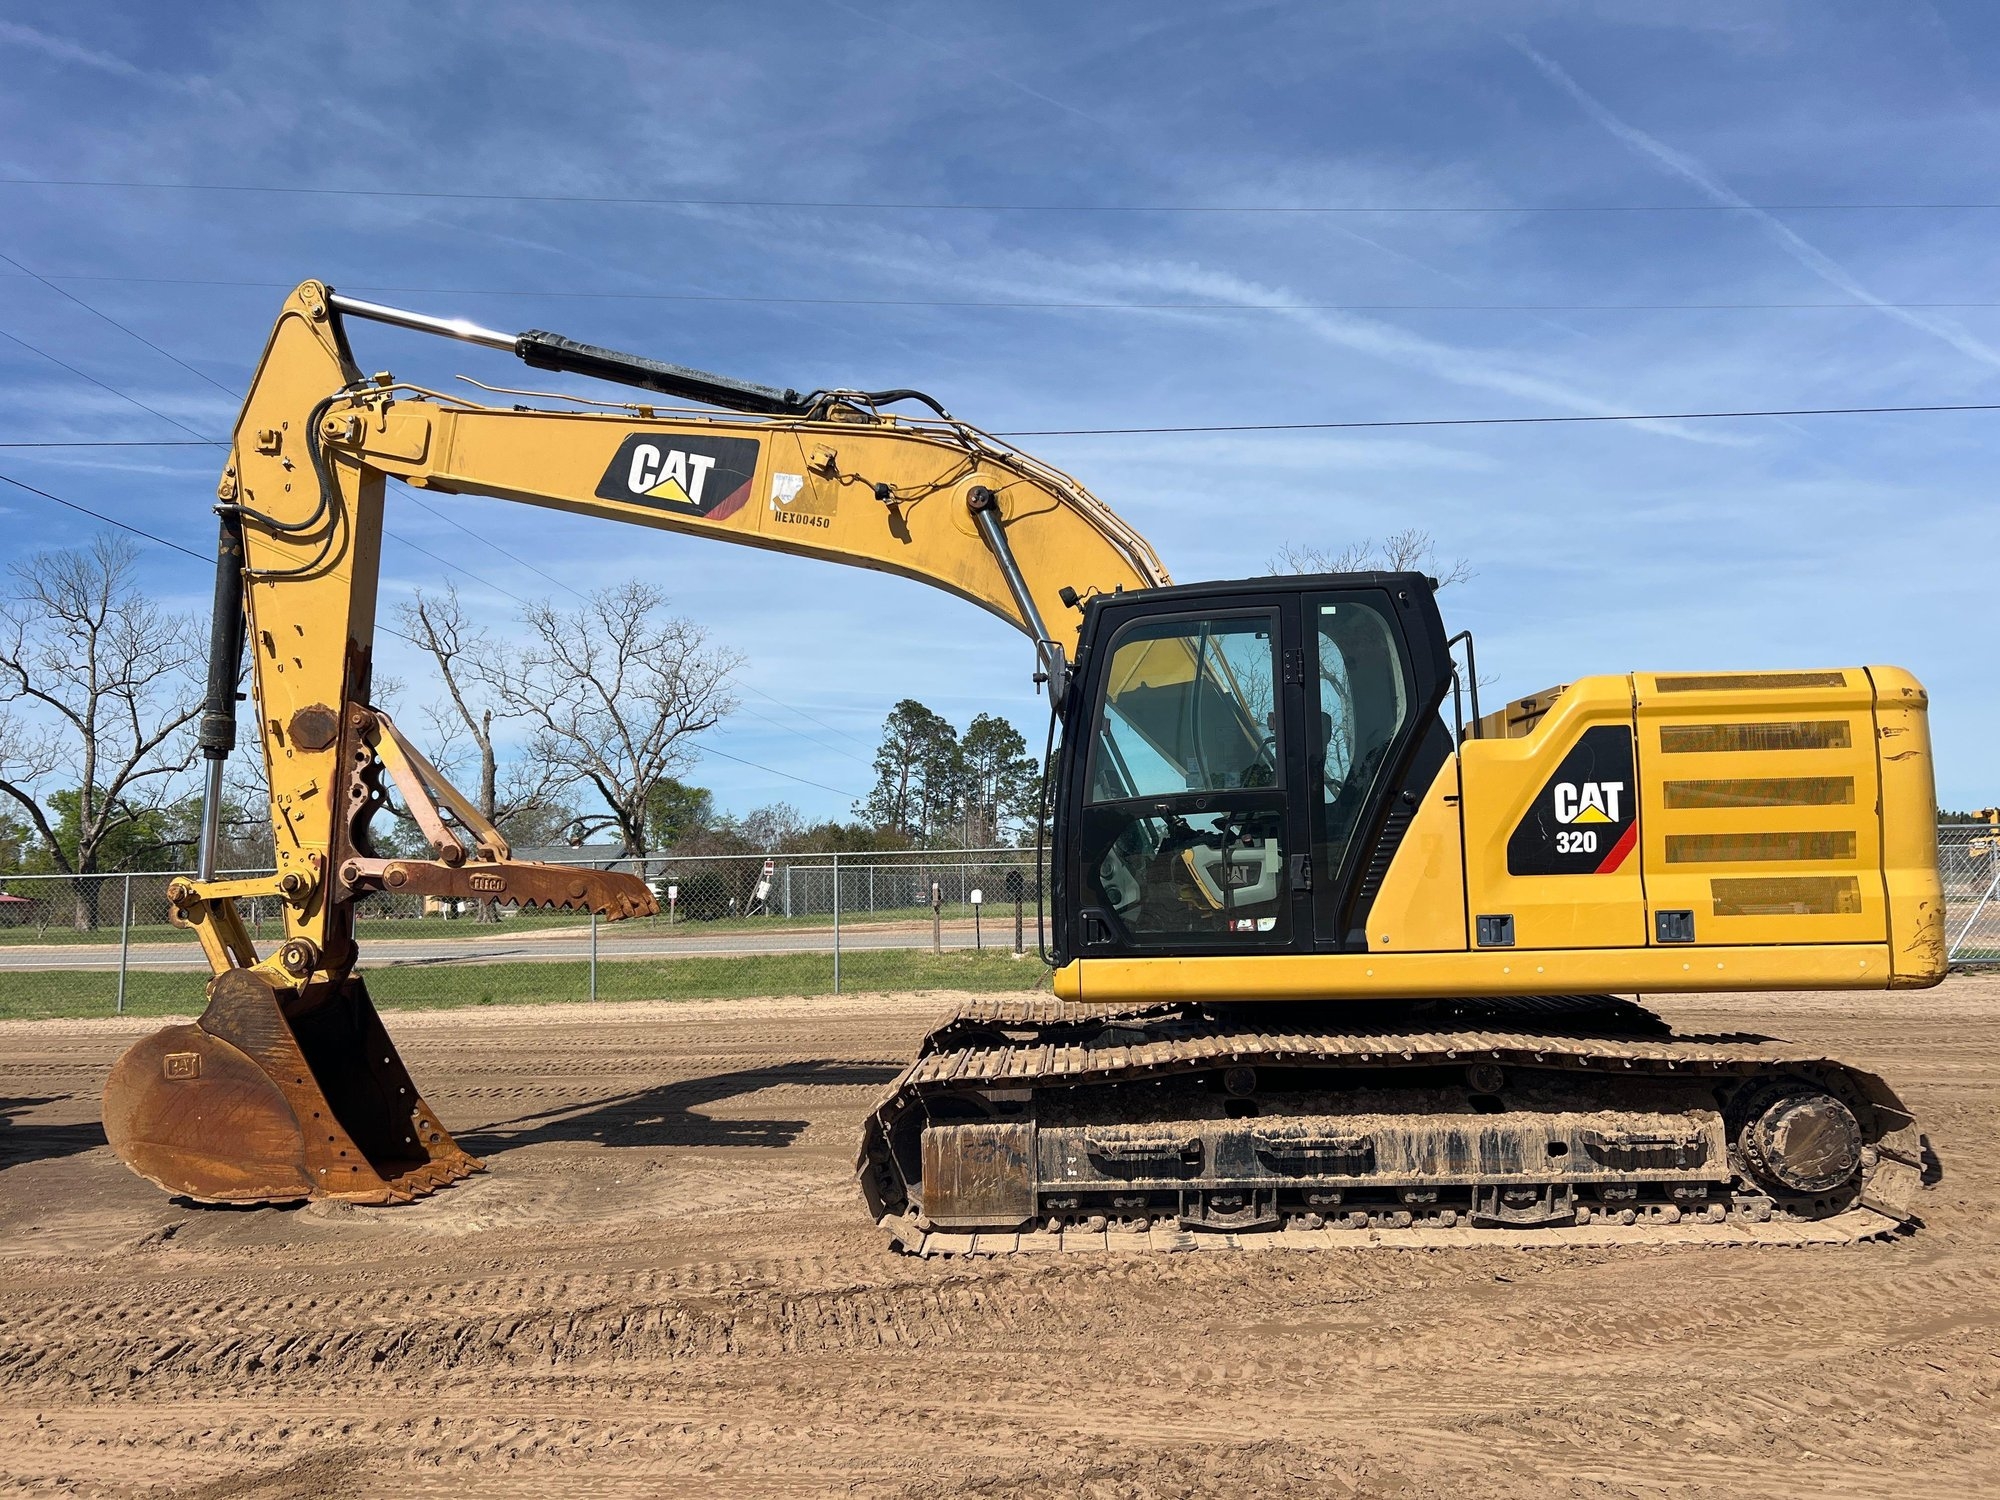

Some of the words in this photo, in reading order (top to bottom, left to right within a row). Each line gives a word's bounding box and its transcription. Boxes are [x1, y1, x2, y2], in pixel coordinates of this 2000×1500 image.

[627, 443, 715, 505] CAT
[775, 511, 830, 528] HEX00450
[1553, 781, 1624, 824] CAT
[1556, 831, 1597, 853] 320
